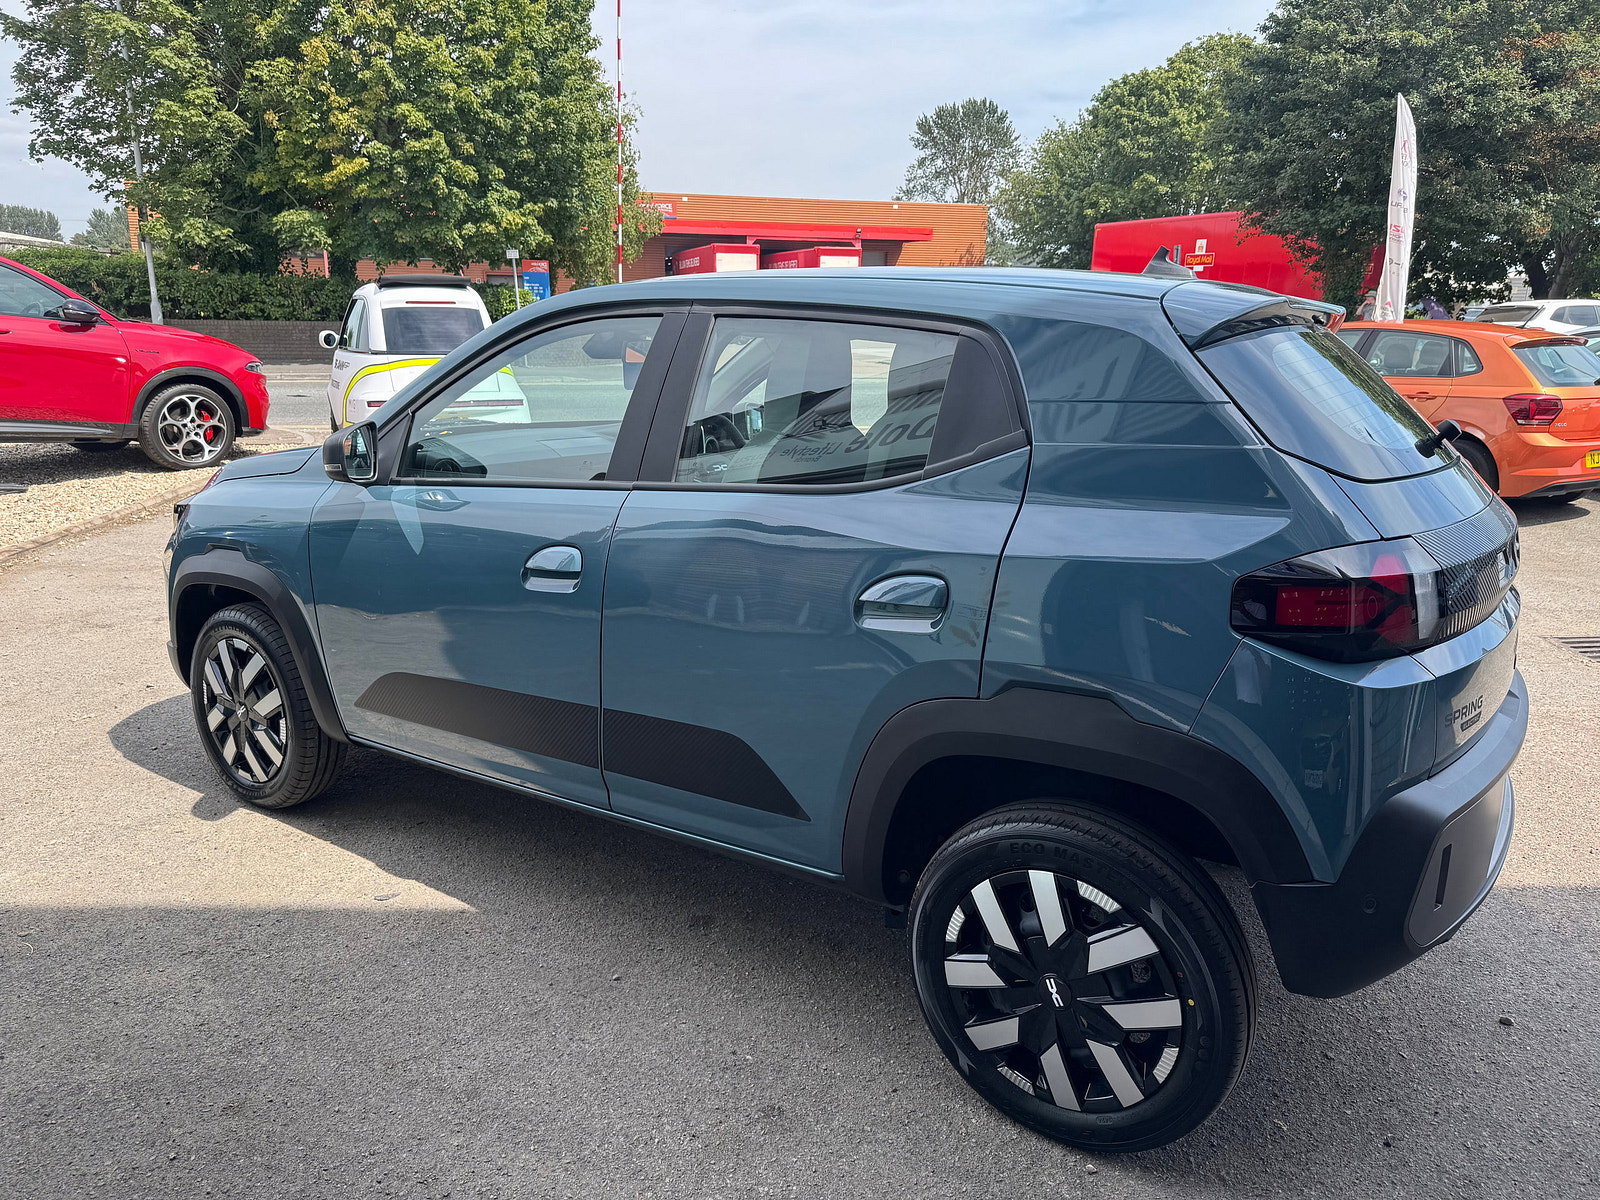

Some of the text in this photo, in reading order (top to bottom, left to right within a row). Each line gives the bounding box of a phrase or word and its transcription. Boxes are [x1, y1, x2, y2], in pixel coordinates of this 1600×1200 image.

[1186, 255, 1212, 265] Royal Mail
[1444, 694, 1484, 729] SPRING
[1009, 841, 1046, 855] ECO
